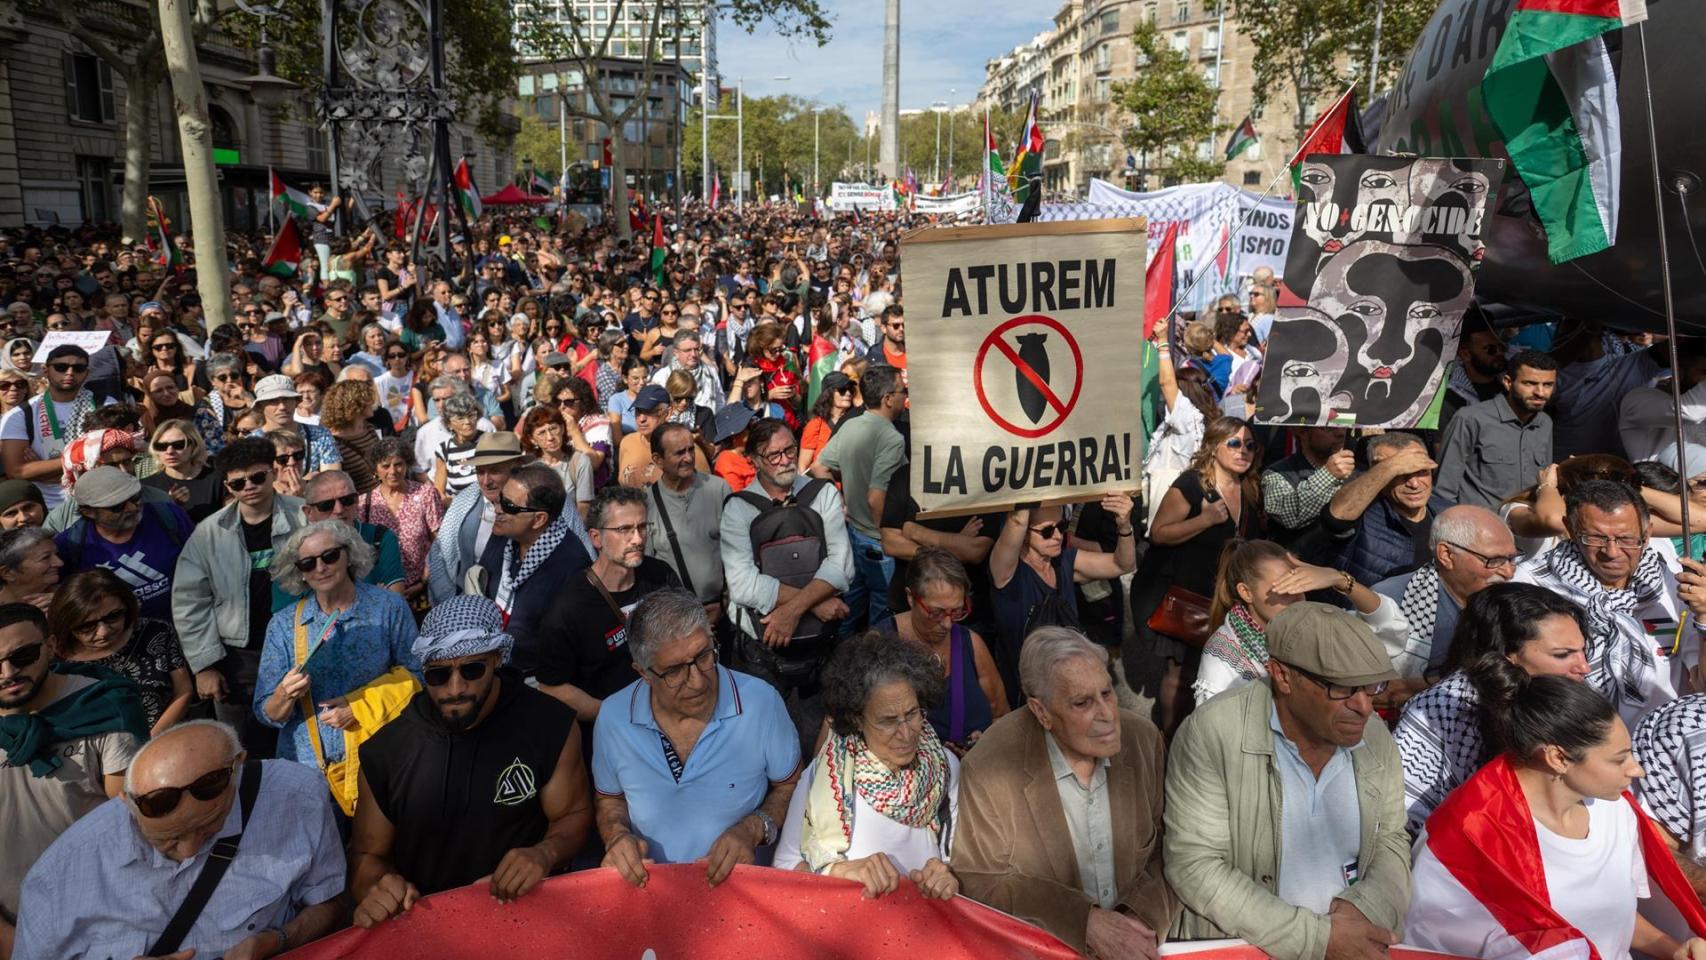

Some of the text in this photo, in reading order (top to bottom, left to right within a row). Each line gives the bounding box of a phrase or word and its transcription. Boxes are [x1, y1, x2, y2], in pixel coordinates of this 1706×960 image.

[1350, 203, 1485, 235] GENOCIDE
[942, 258, 1116, 317] ATUREM
[923, 433, 1131, 494] LA GUERRA!
